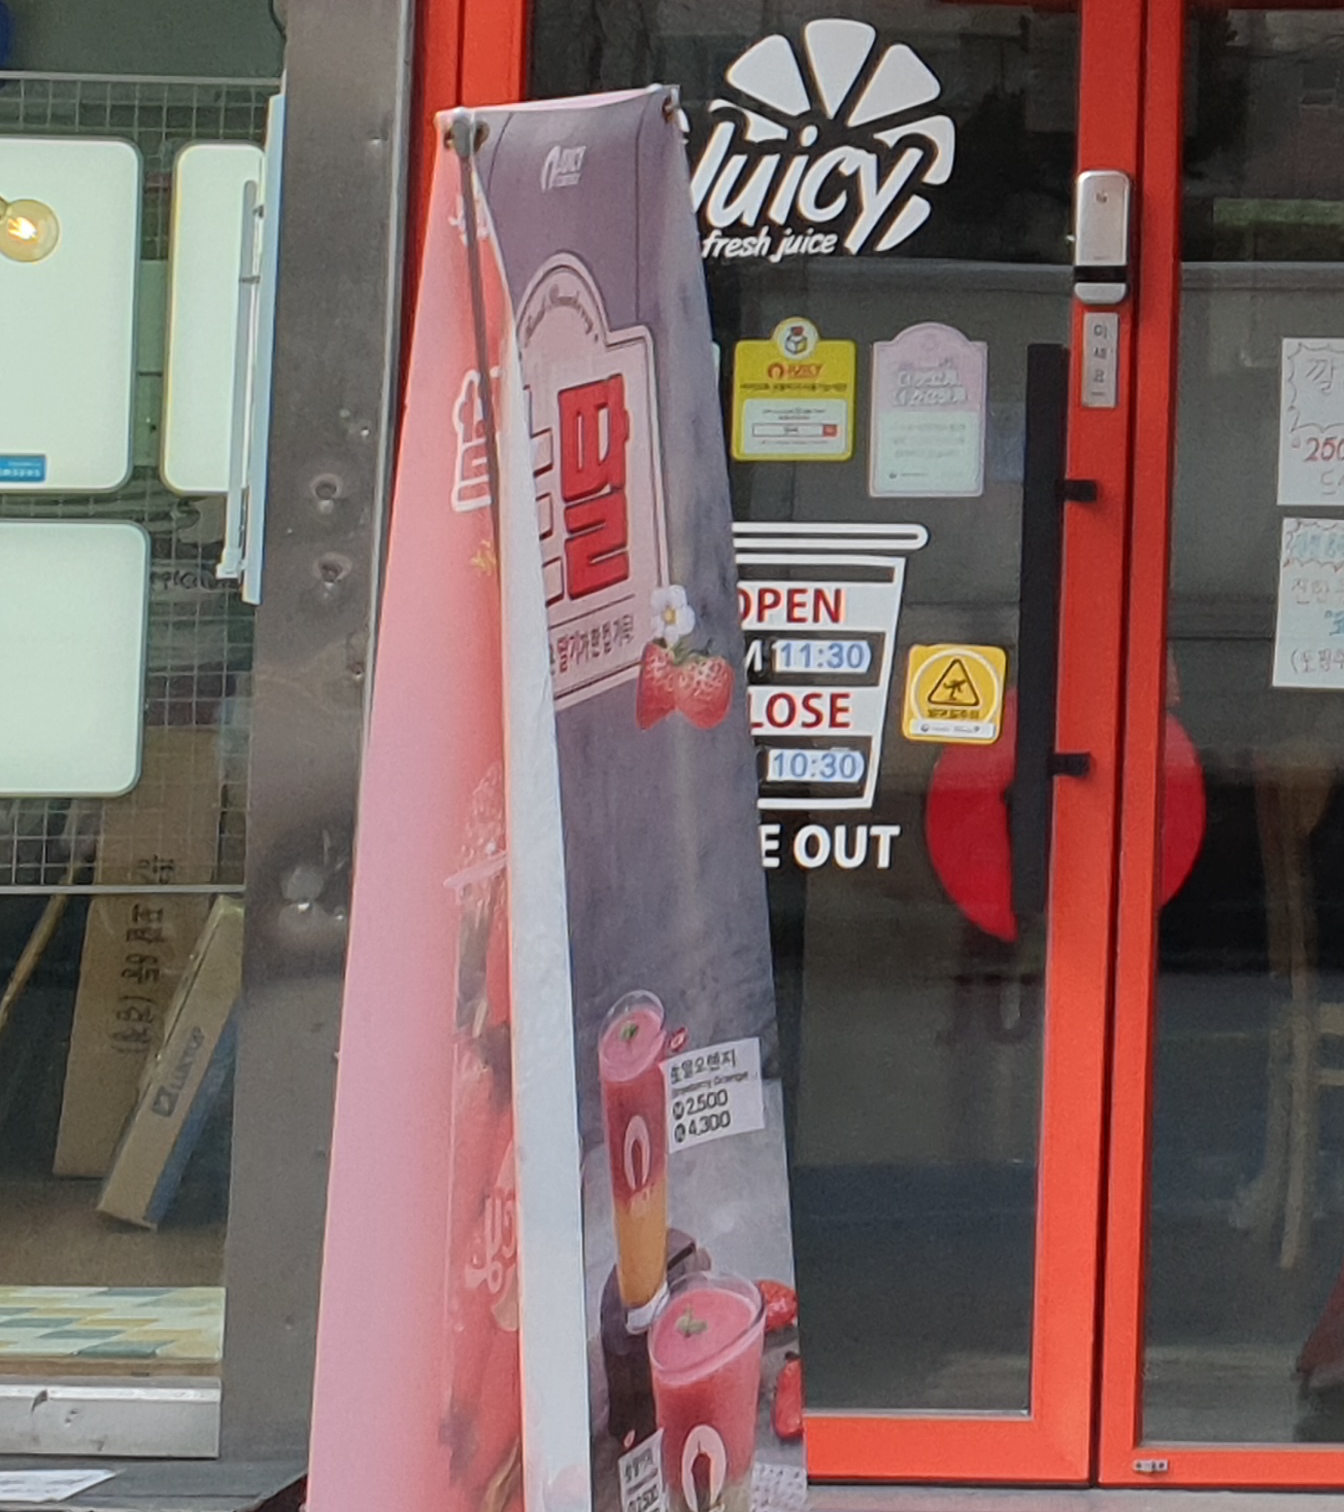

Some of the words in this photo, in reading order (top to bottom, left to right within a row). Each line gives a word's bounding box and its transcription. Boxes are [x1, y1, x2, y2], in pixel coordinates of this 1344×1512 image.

[701, 228, 769, 259] fresh
[770, 228, 838, 263] juice
[779, 643, 865, 670] 11:30
[749, 692, 852, 730] LOSE
[773, 753, 858, 779] 10:30
[793, 824, 901, 869] OUT
